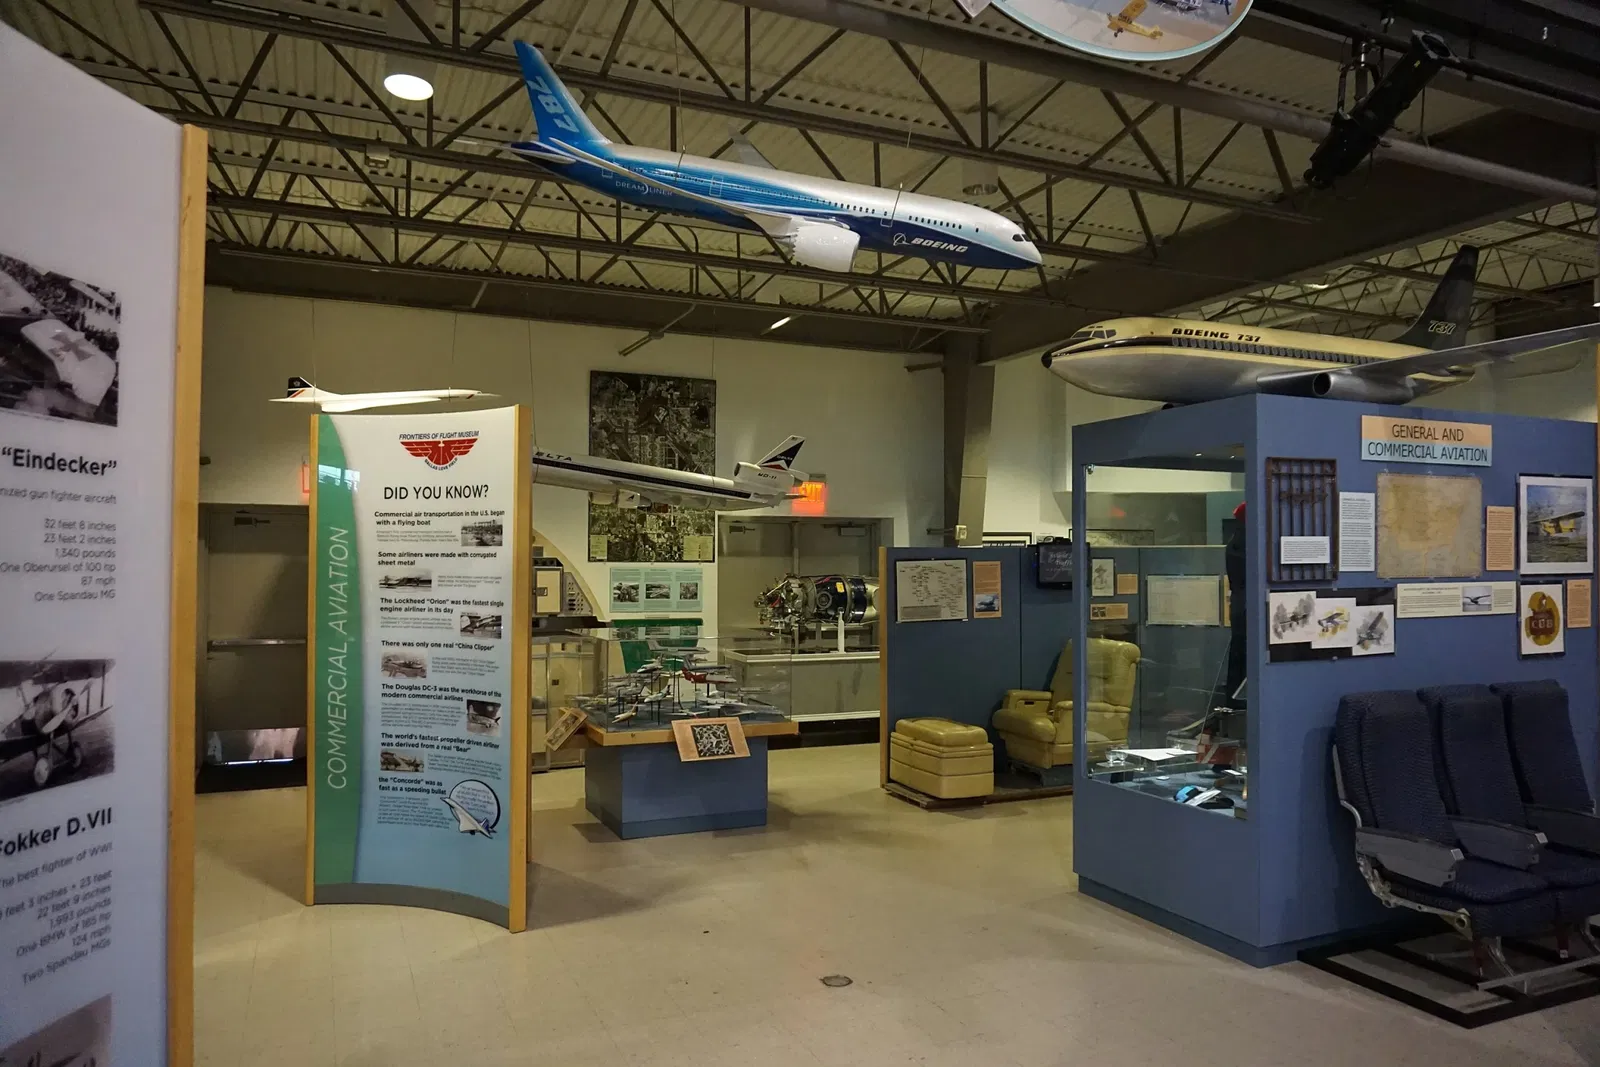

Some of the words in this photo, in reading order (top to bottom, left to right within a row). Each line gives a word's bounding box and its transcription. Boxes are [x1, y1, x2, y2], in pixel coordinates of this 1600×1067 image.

[526, 75, 579, 133] 787
[911, 237, 968, 253] BOEING
[1428, 320, 1456, 335] 737
[1171, 327, 1229, 340] BOEING
[1236, 333, 1261, 343] 737
[440, 431, 457, 439] FLIGHT
[458, 430, 479, 438] MUSEUM
[1392, 424, 1439, 440] GENERAL
[1442, 428, 1464, 442] AND
[1368, 441, 1437, 459] COMMERCIAL
[1440, 446, 1487, 462] AVIATION
[384, 486, 408, 500] DID
[413, 486, 441, 500] YOU
[445, 484, 489, 499] KNOW?
[423, 510, 464, 519] transportation
[490, 510, 505, 518] began
[397, 519, 416, 527] flying
[470, 552, 497, 560] corrugated
[328, 526, 349, 635] AVIATION
[380, 606, 402, 614] engine
[443, 607, 453, 615] day
[490, 600, 504, 608] single
[415, 641, 429, 649] only
[395, 684, 421, 692] Douglas
[461, 687, 487, 696] workhorse
[408, 692, 443, 701] commercial
[444, 694, 464, 702] airlines
[328, 641, 348, 789] COMMERCIAL
[395, 741, 419, 749] derived
[420, 742, 435, 750] from
[441, 743, 452, 751] real
[419, 734, 439, 742] fastest
[440, 736, 466, 745] propeller
[466, 738, 482, 746] driven
[483, 740, 500, 749] airliner
[405, 786, 430, 795] speeding
[67, 807, 112, 837] D.VII
